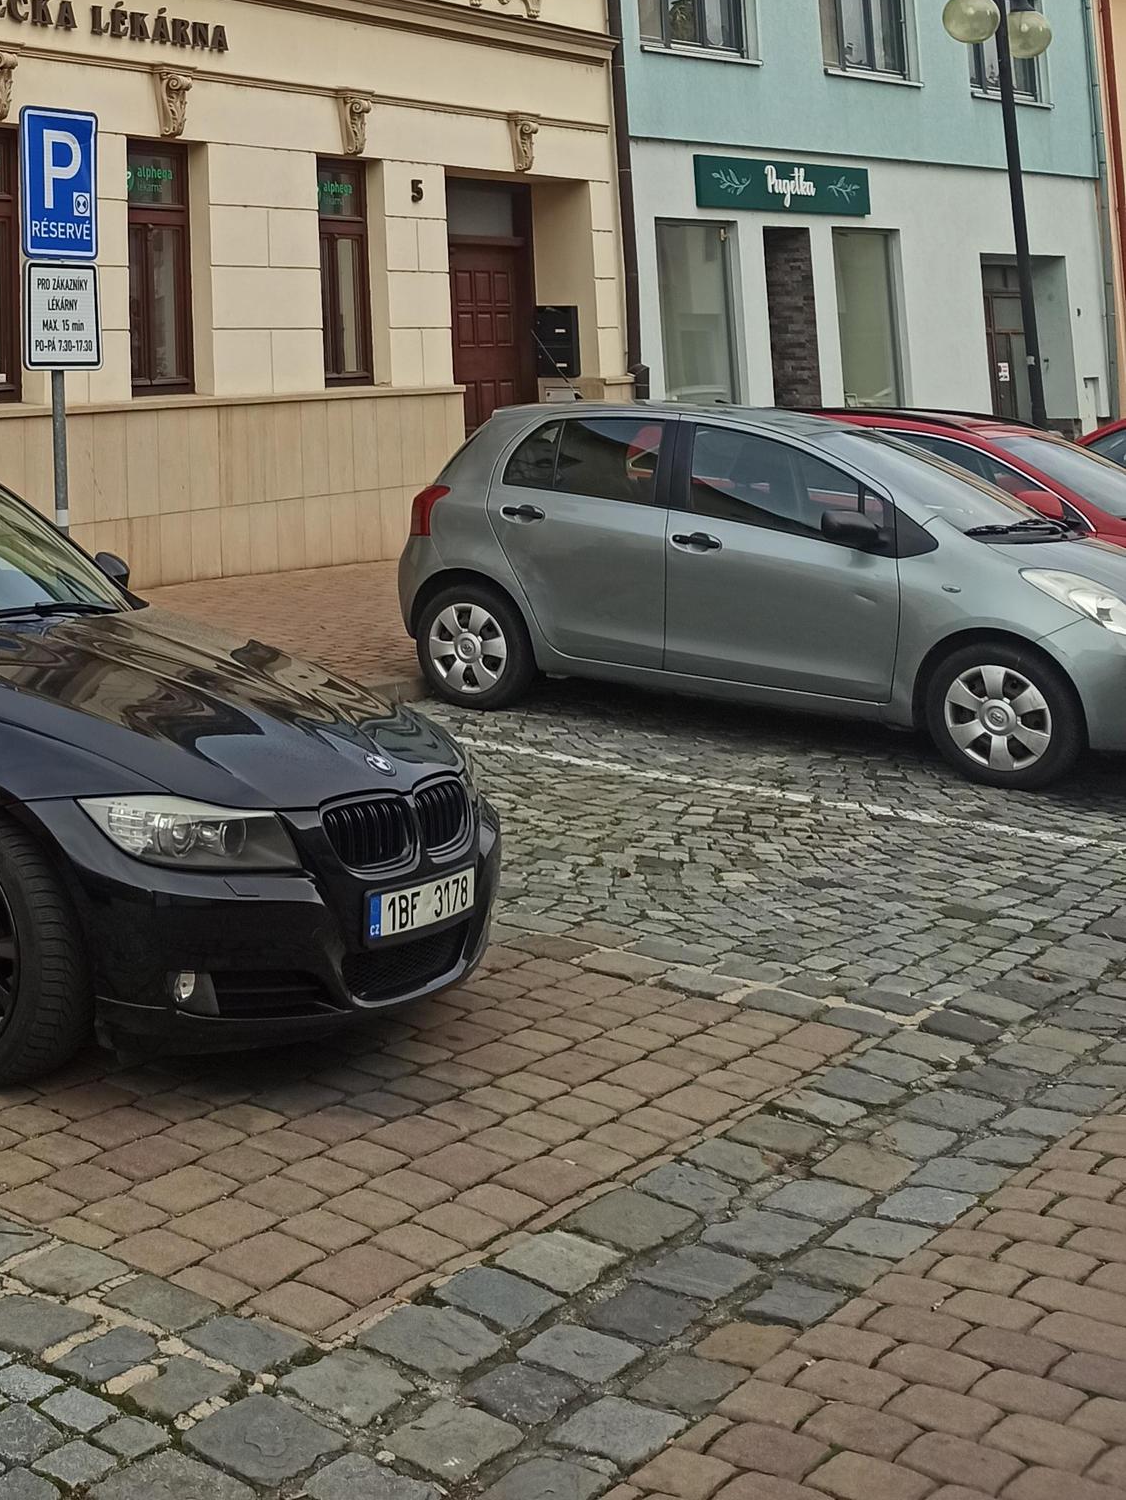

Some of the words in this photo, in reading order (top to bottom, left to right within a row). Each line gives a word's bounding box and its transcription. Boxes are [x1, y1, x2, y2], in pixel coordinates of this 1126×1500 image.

[90, 1, 230, 52] LÉKÁRNA
[43, 128, 82, 210] P
[137, 165, 173, 181] alphega
[323, 180, 353, 197] alphega
[411, 179, 424, 202] 5
[31, 218, 92, 241] RÉSERVÉ
[37, 278, 51, 291] PRO
[53, 275, 88, 291] ZÁKAZNÍKY
[47, 296, 78, 311] LÉKÁRNY
[42, 319, 60, 331] MAX.
[62, 319, 70, 331] 15
[71, 320, 85, 331] min
[35, 336, 56, 352] PO-PÁ
[388, 891, 421, 931] 1BF
[434, 875, 468, 918] 3178
[370, 924, 380, 936] CZ
